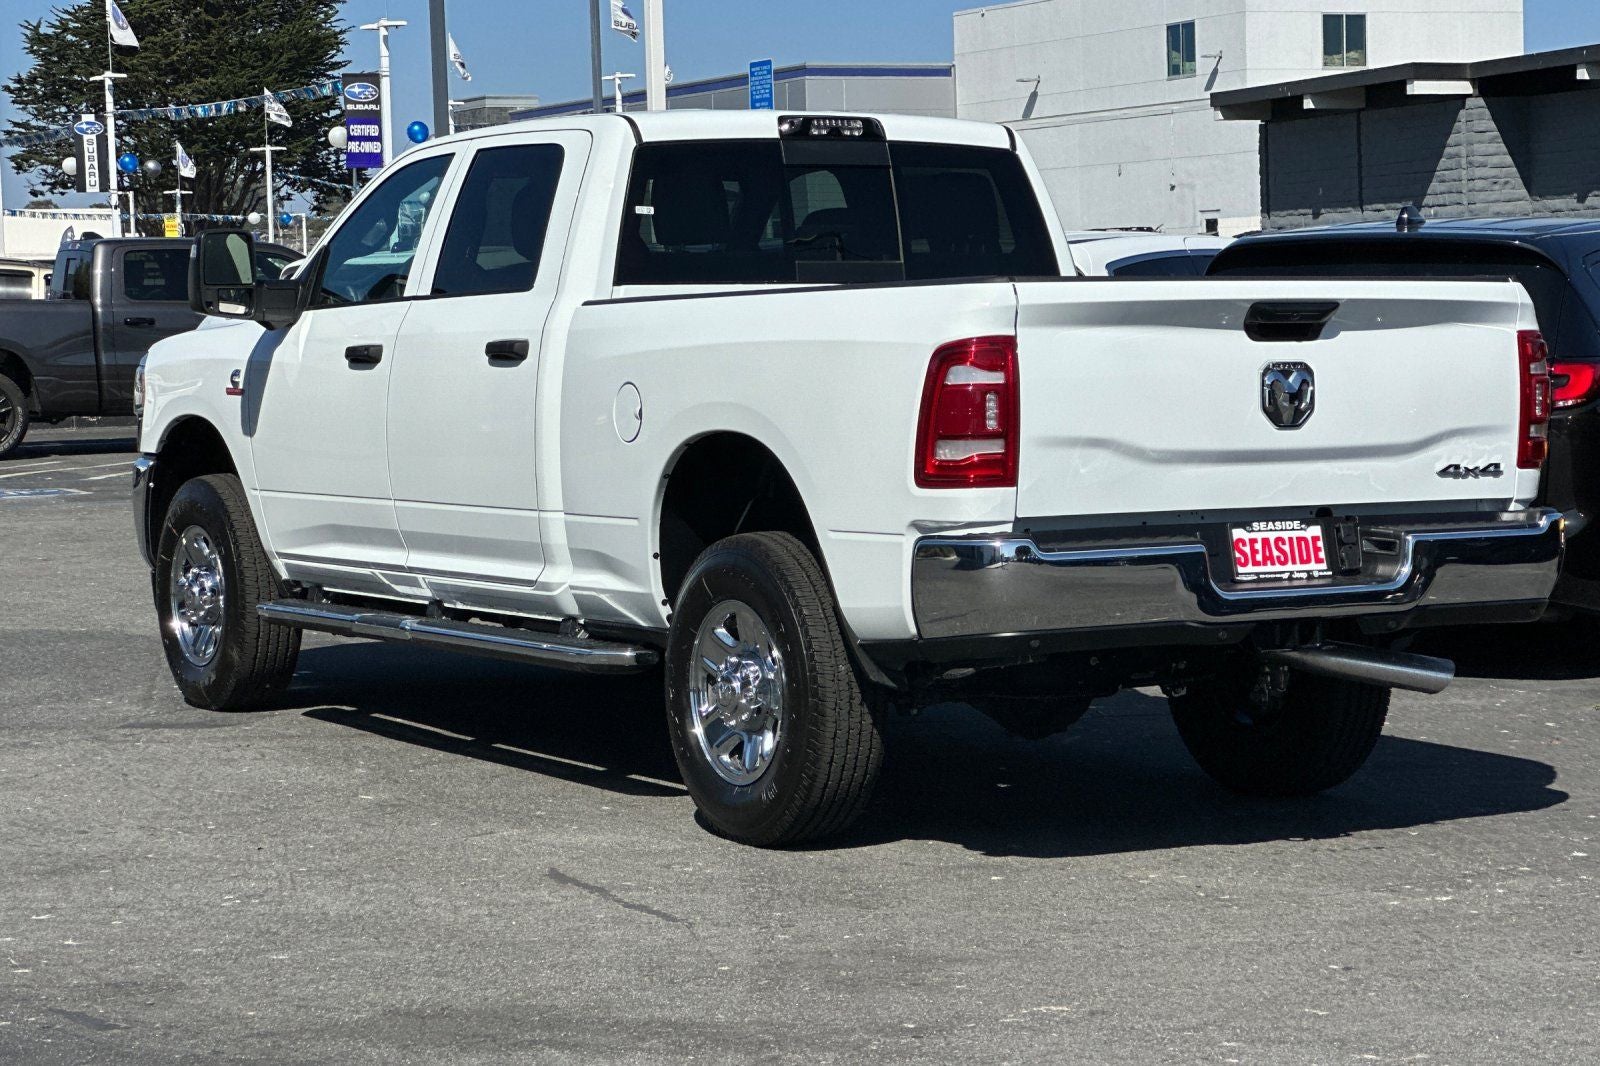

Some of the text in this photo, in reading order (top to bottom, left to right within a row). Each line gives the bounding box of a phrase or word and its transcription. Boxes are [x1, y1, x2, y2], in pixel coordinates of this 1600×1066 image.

[349, 124, 379, 136] CERTIFIED
[347, 141, 382, 153] PRE-OWNED
[86, 138, 97, 187] SUBARU
[1252, 520, 1301, 531] SEASIDE
[1233, 535, 1325, 568] SEASIDE
